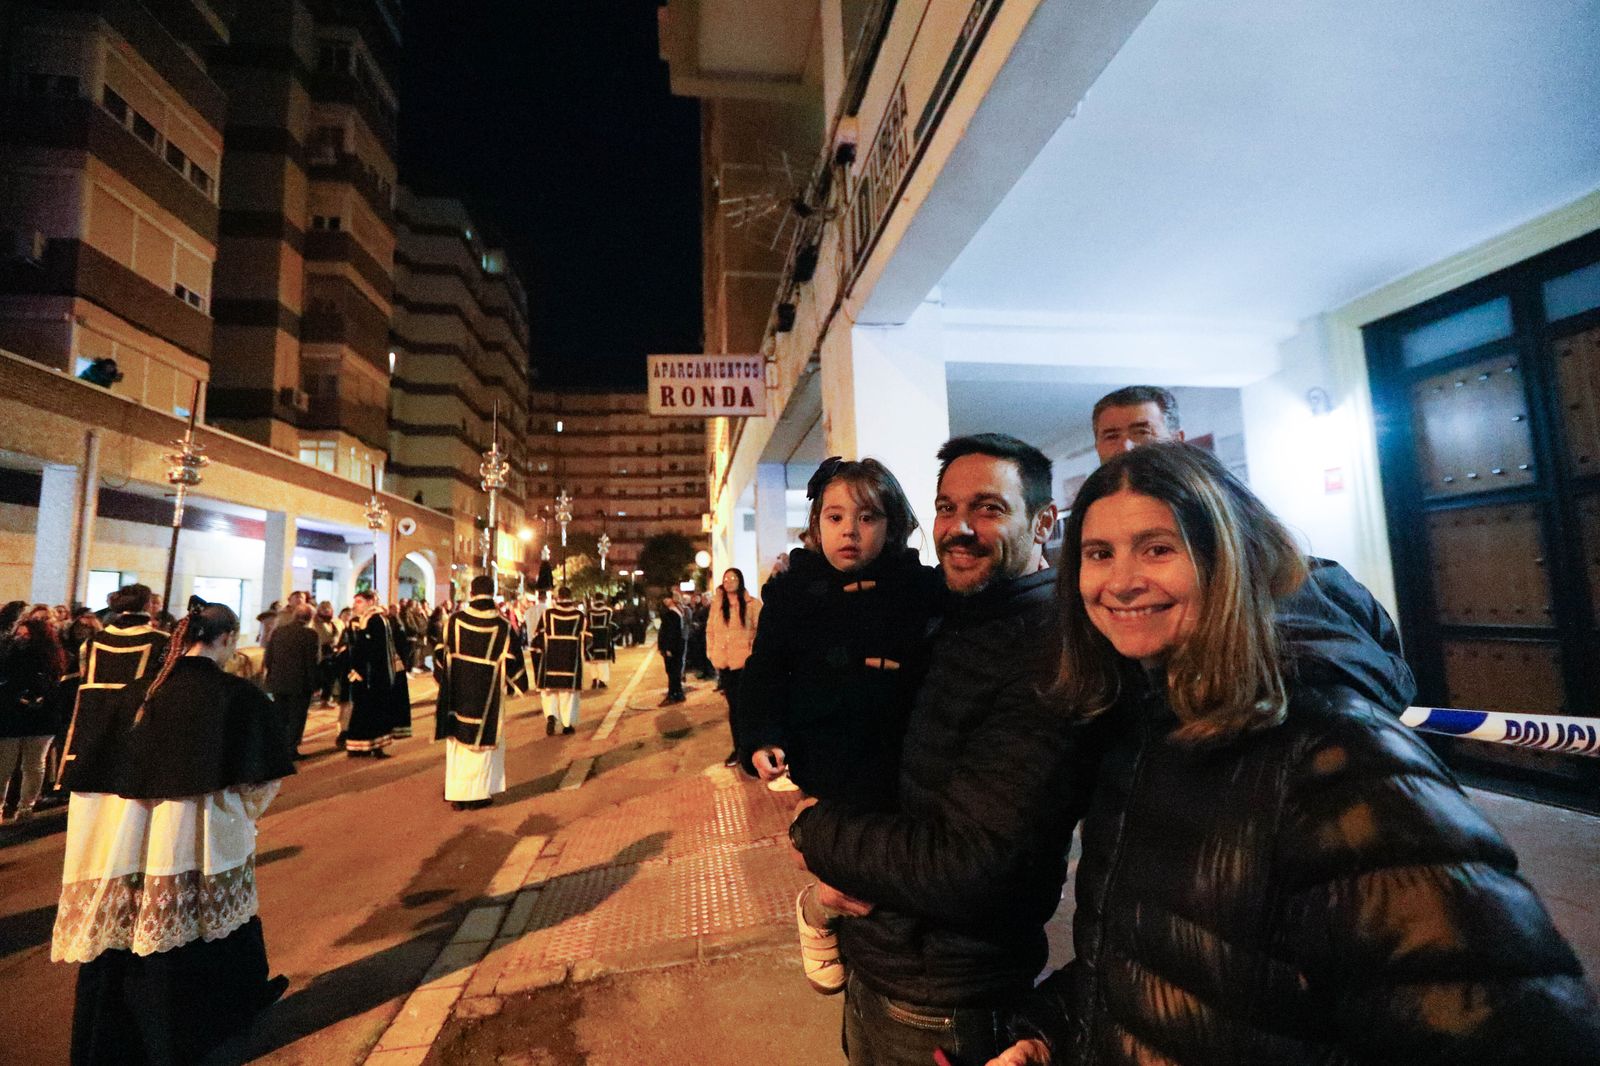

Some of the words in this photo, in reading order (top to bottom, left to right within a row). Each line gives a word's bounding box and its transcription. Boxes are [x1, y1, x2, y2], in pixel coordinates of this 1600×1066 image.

[654, 363, 760, 379] APARCAMIENTOS
[660, 386, 755, 407] RONDA
[1500, 719, 1600, 755] POLICI
